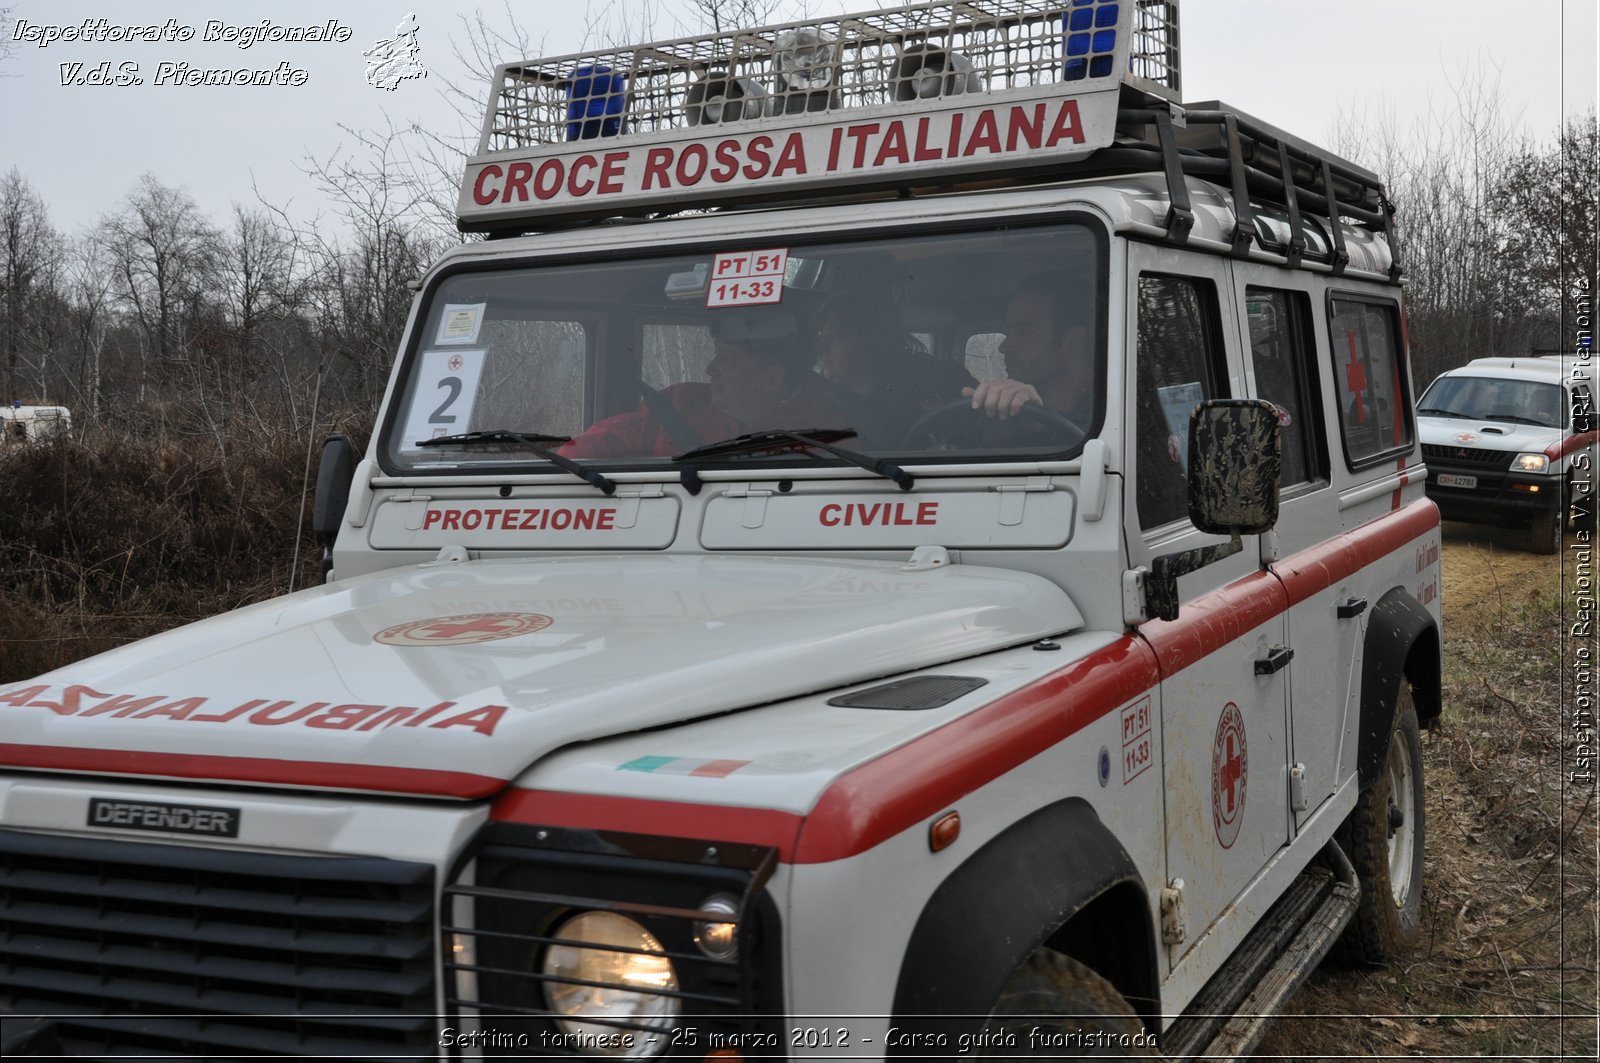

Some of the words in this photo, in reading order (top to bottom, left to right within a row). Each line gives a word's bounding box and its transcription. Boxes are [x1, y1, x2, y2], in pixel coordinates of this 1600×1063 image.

[474, 152, 628, 205] CROCE
[641, 133, 807, 190] ROSSA
[827, 100, 1085, 172] ITALIANA
[718, 258, 747, 274] PT
[755, 255, 780, 271] 51
[716, 281, 774, 300] 11-33
[428, 376, 462, 424] 2
[423, 508, 616, 531] PROTEZIONE
[818, 502, 938, 527] CIVILE
[1124, 714, 1136, 739] PT
[1138, 705, 1149, 729] 51
[1126, 740, 1150, 773] 11-33
[95, 802, 230, 833] DEFENDER
